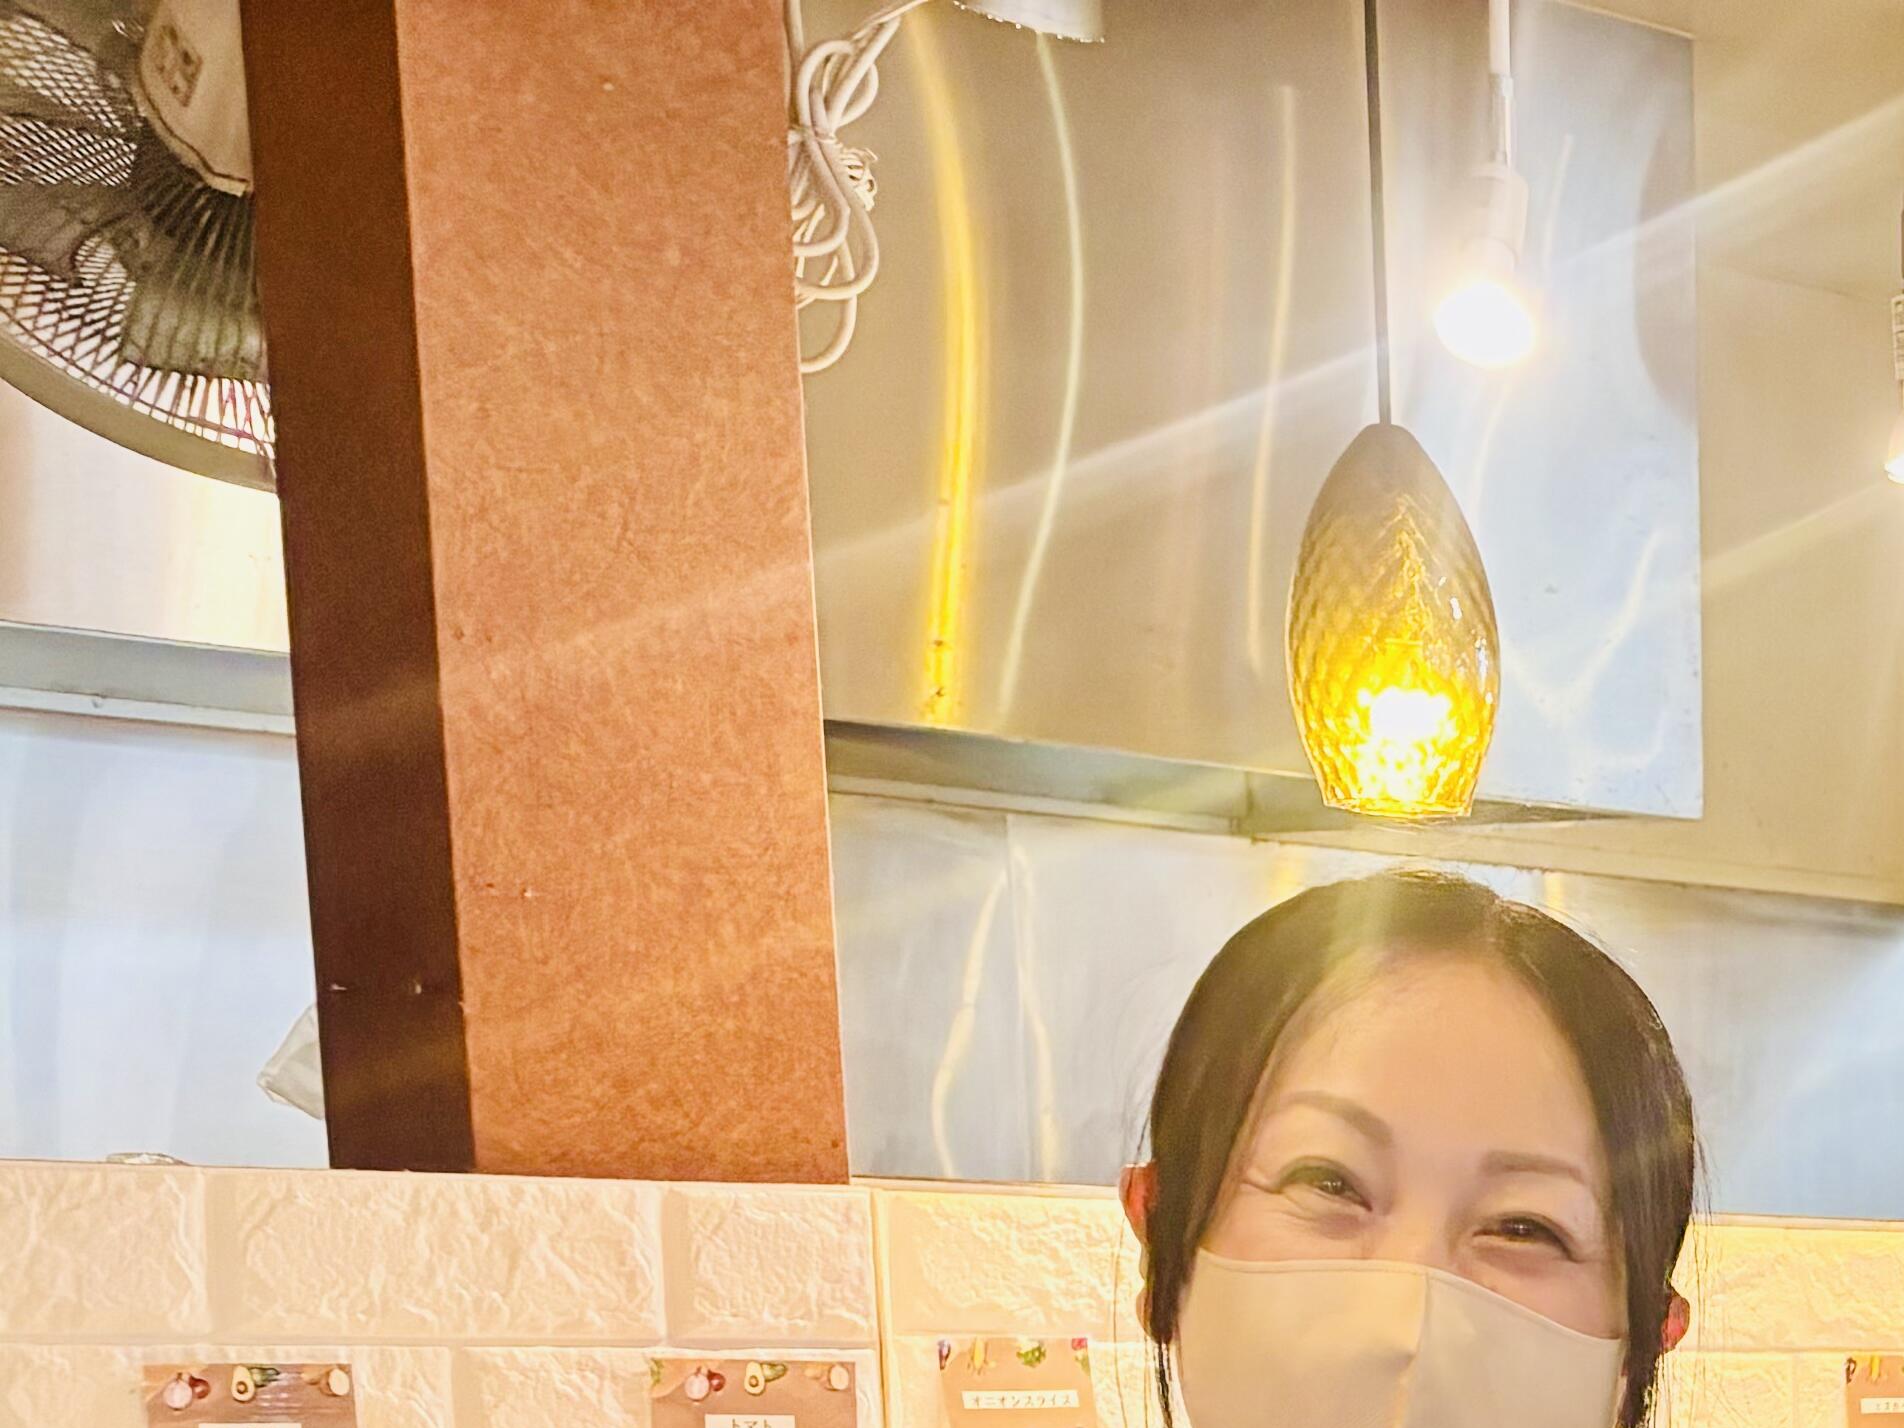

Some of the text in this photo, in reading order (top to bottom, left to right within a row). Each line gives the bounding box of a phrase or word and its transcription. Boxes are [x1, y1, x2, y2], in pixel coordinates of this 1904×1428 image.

[972, 1393, 1073, 1407] オニオンスライス
